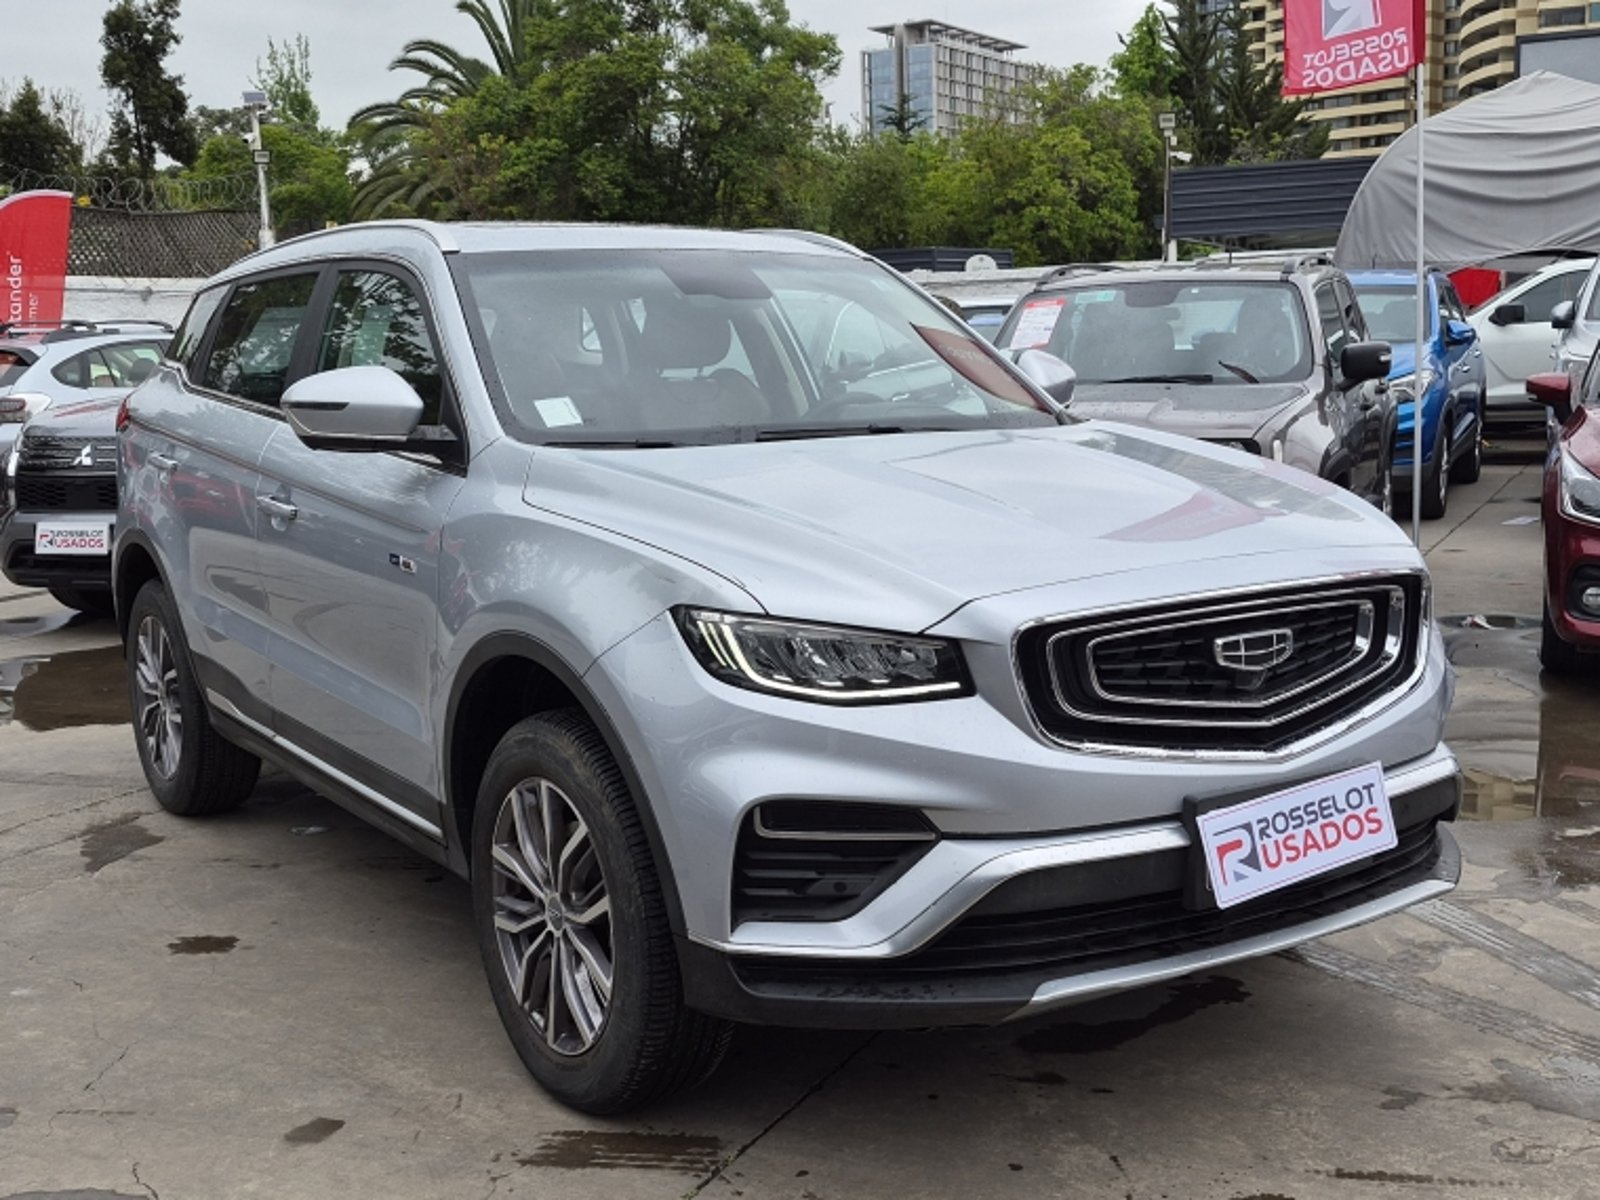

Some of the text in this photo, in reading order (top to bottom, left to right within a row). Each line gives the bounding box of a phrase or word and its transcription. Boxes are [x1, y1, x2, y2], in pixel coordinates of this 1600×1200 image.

[6, 255, 22, 328] tander
[55, 538, 104, 548] USADOS
[1256, 783, 1375, 841] ROSSELOT
[1261, 807, 1384, 869] USADOS
